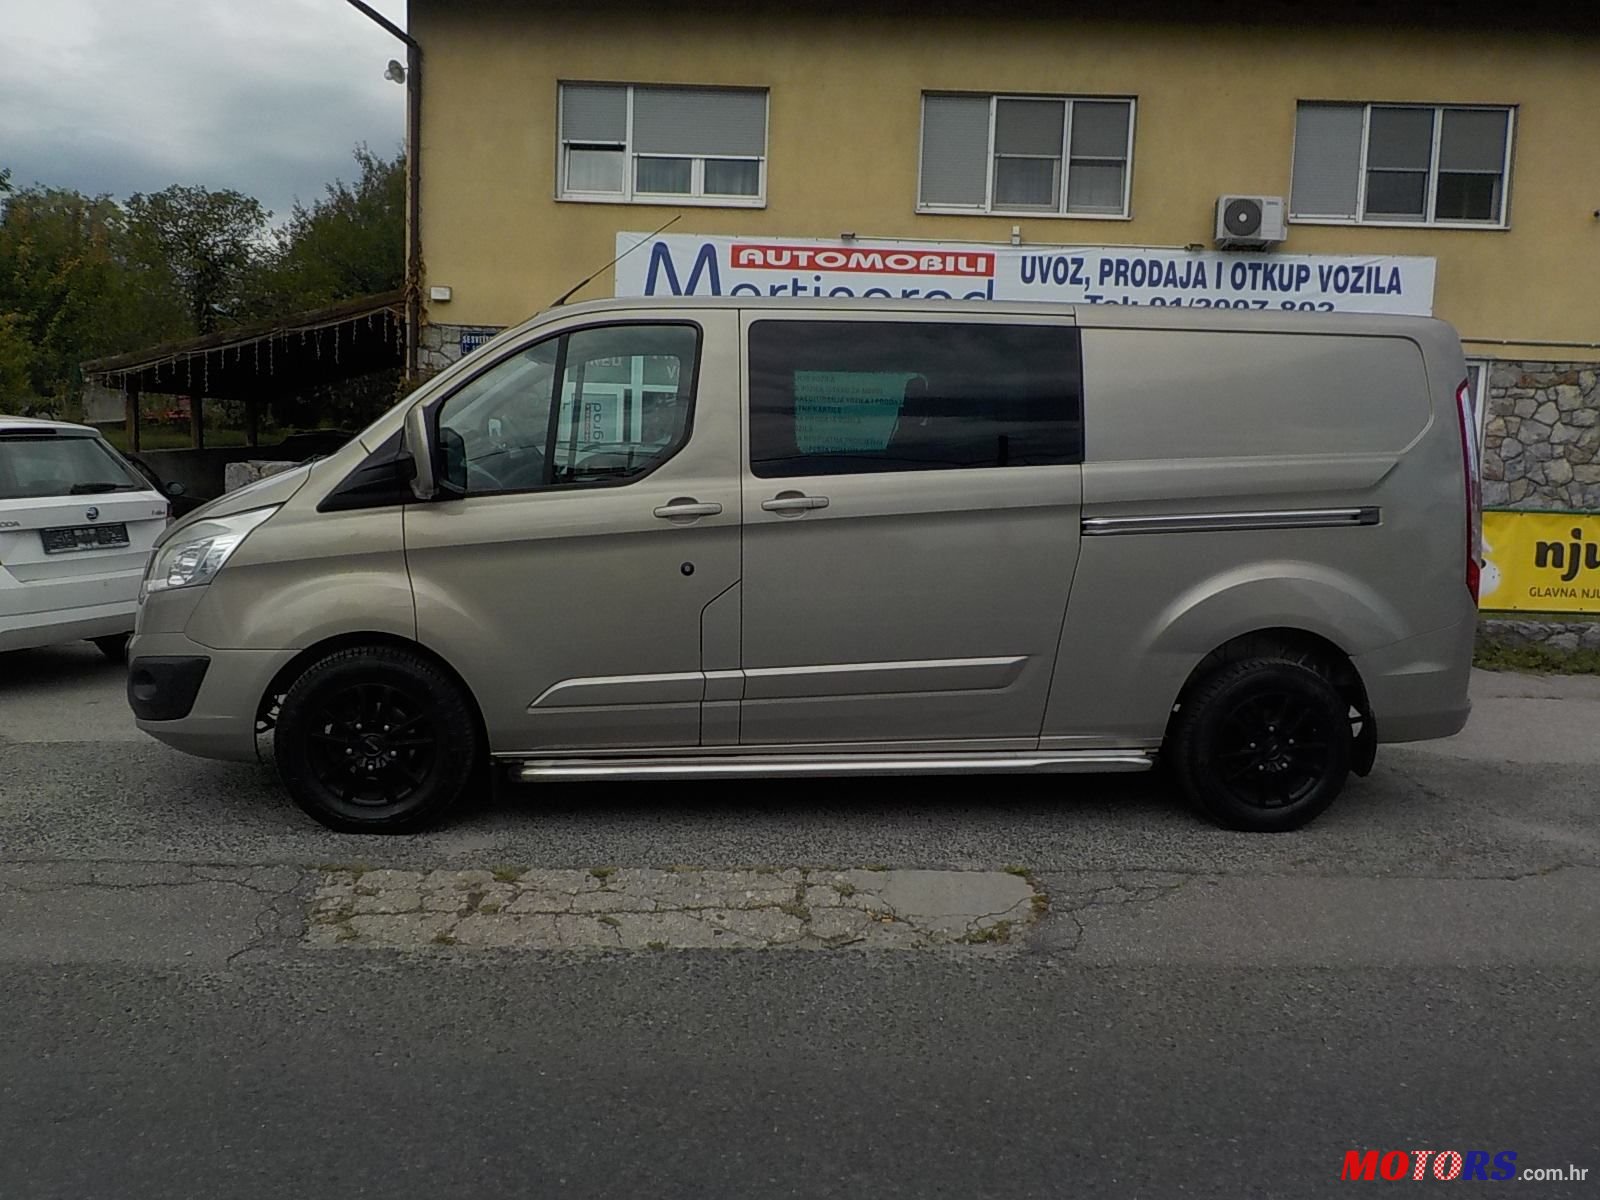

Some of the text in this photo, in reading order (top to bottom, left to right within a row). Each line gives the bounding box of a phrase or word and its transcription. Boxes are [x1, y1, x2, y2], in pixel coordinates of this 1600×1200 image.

[738, 248, 987, 273] AUTOMOBILI
[1020, 255, 1091, 290] UVOZ,
[1099, 257, 1207, 290] PRODAJA
[1215, 261, 1222, 290] I
[1230, 261, 1311, 293] OTKUP
[1318, 265, 1402, 296] VOZILA
[1529, 586, 1577, 599] GLAVNA
